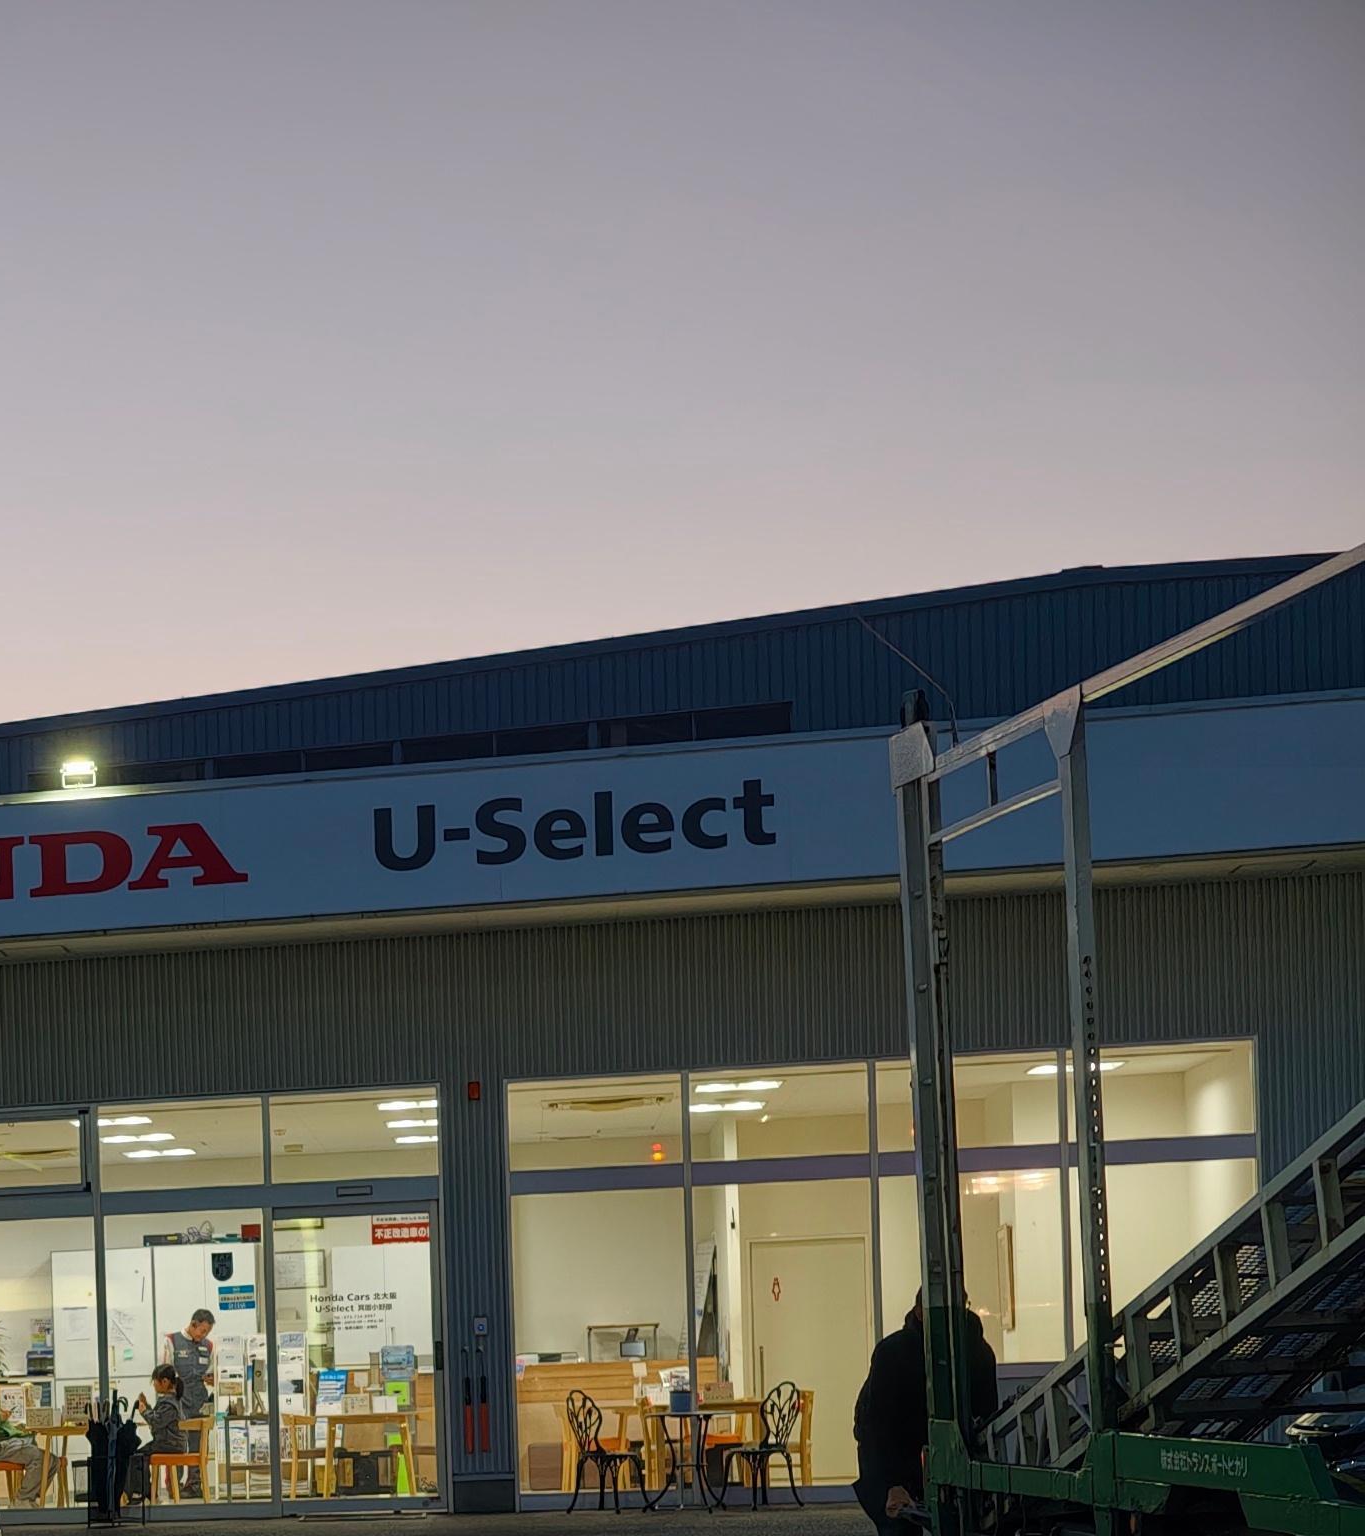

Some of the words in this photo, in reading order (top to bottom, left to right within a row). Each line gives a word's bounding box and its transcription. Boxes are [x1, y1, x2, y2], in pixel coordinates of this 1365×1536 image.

[374, 779, 777, 871] U-Select
[310, 1293, 344, 1302] Honda
[347, 1292, 371, 1301] Cars
[373, 1291, 397, 1300] 北大阪
[315, 1304, 354, 1313] U-Select
